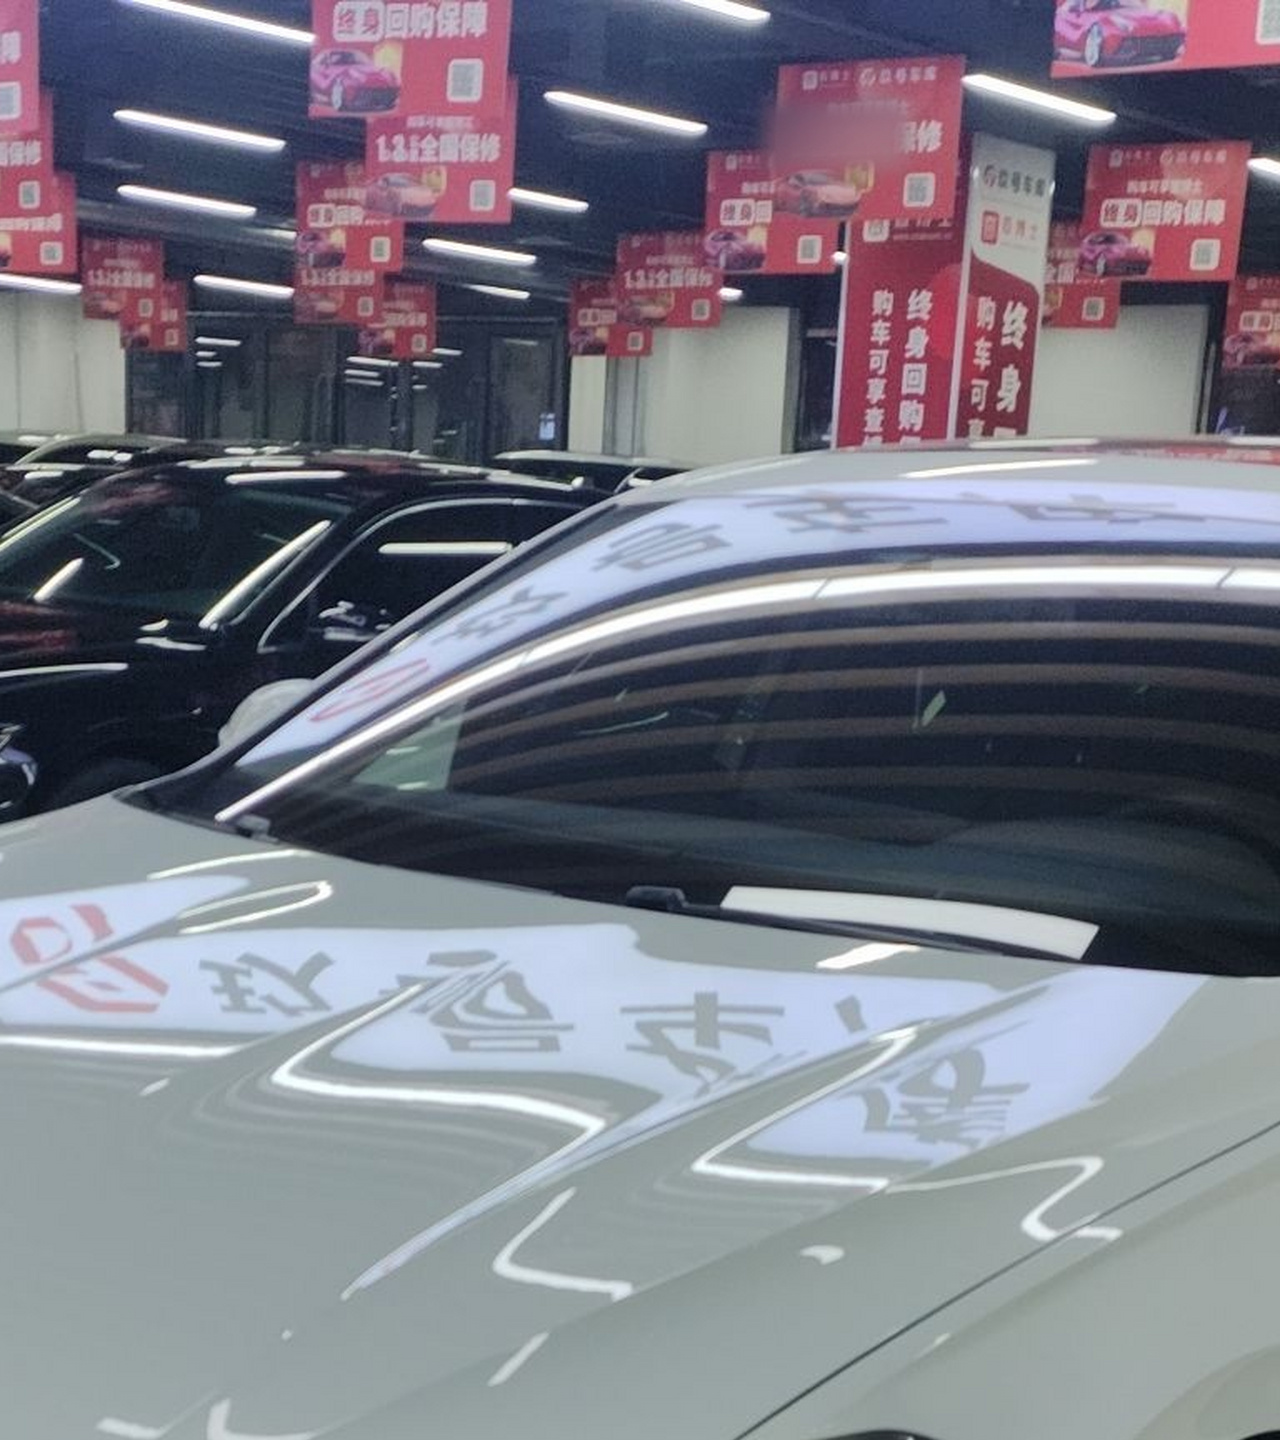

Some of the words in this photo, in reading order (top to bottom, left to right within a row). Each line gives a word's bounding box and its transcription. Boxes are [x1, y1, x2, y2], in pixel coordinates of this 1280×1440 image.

[335, 1, 488, 39] 终身回购保障
[1101, 199, 1225, 227] 终身回购保障
[898, 289, 933, 446] 终身回购
[993, 300, 1029, 437] 终身
